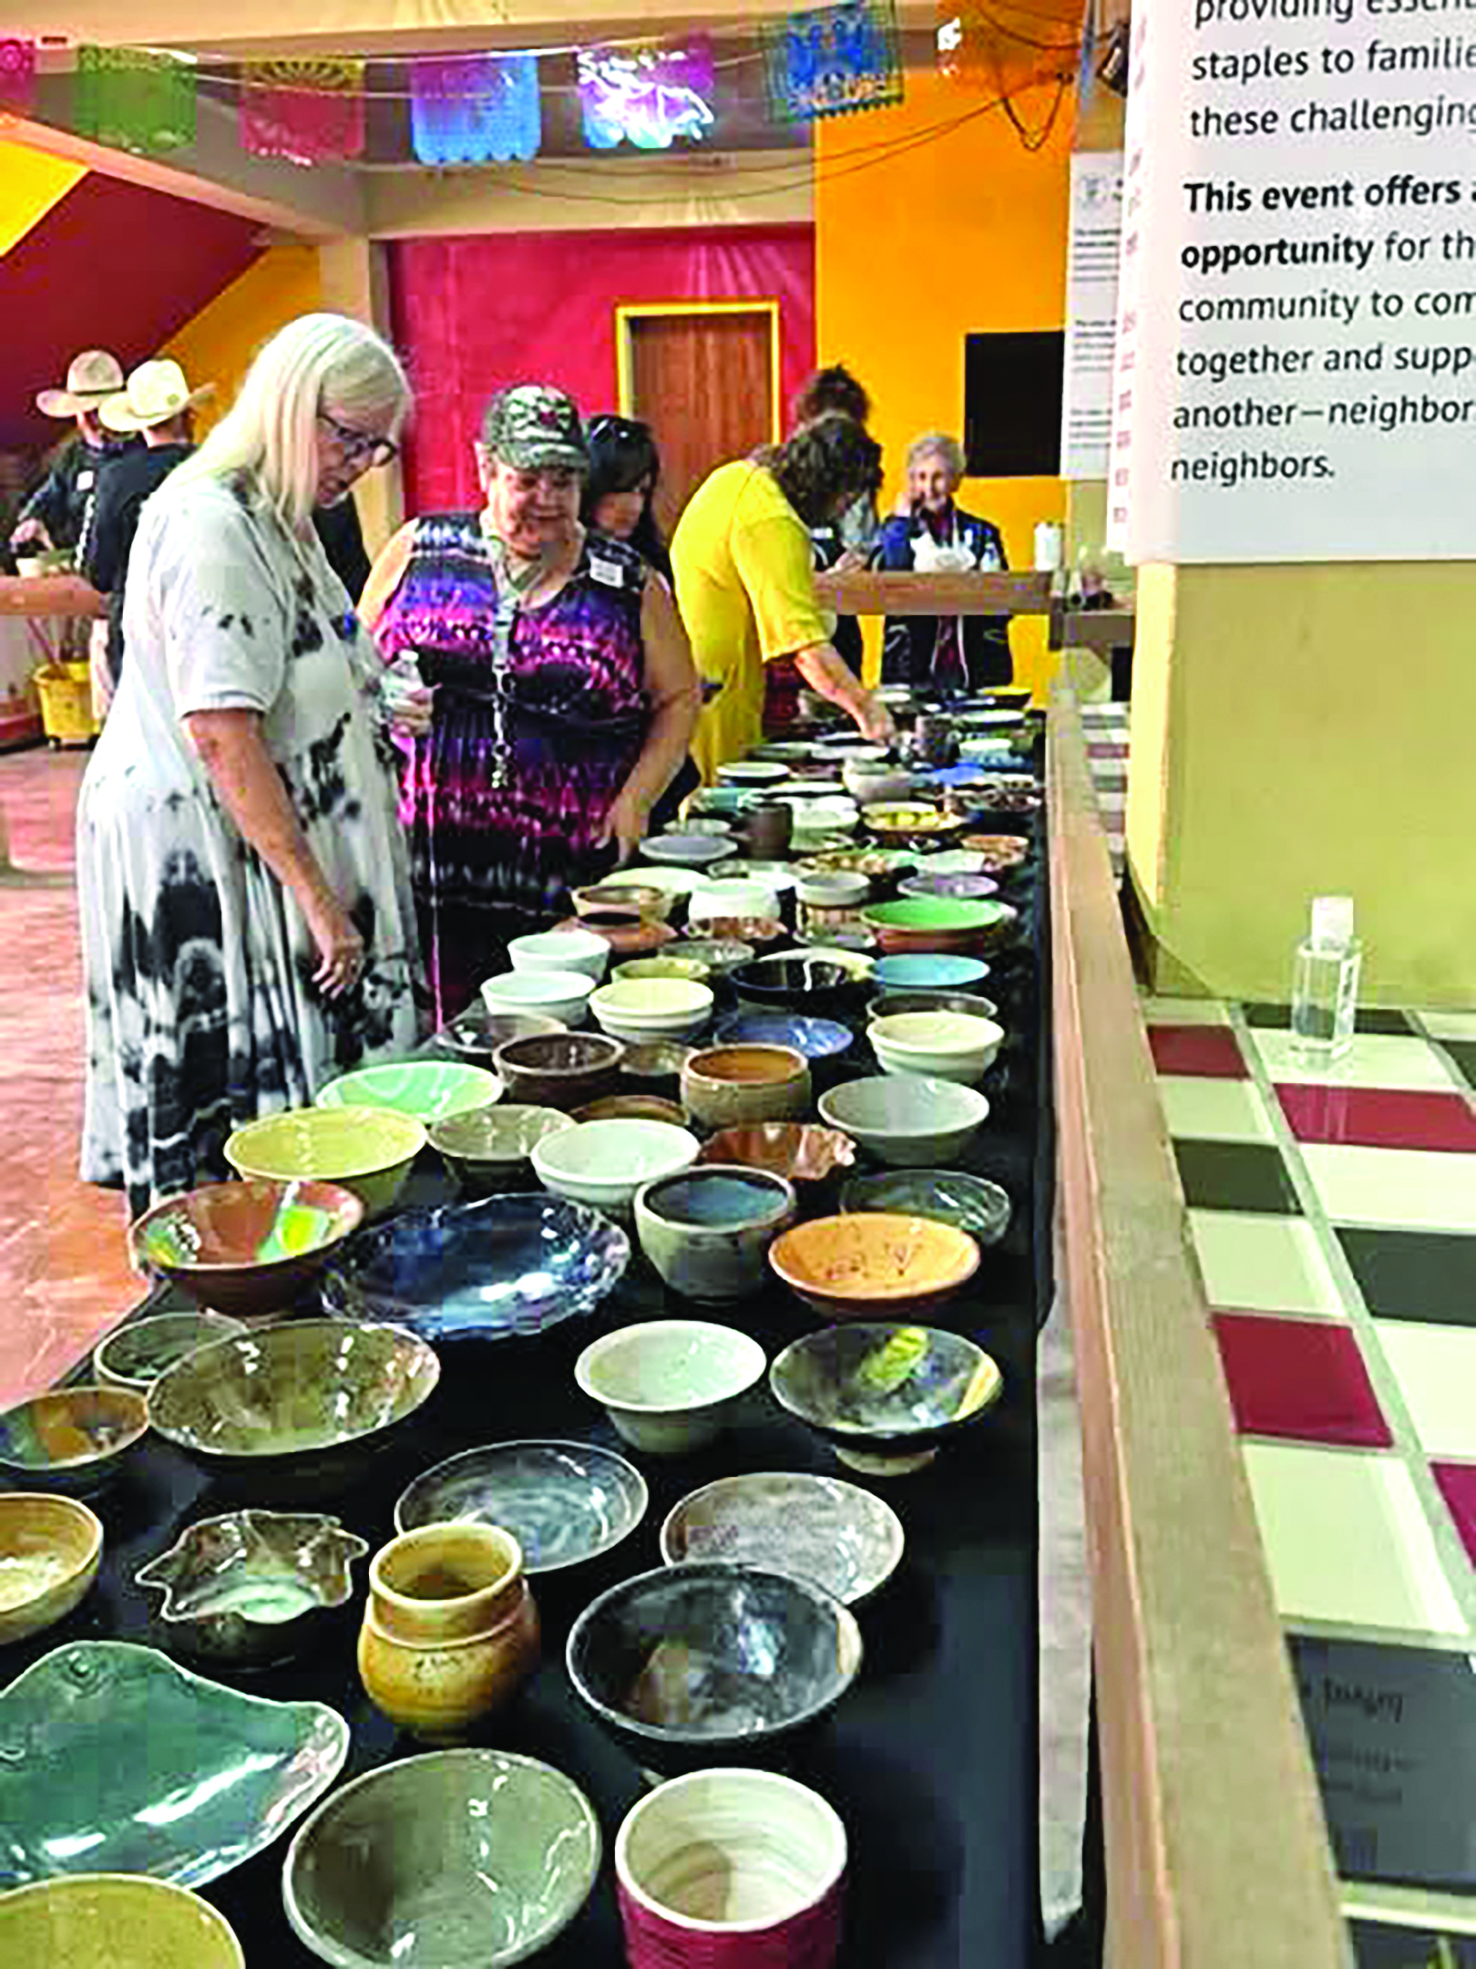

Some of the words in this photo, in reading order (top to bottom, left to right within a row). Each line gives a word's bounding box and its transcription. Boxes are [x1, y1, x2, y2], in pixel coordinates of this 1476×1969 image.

[1192, 46, 1309, 86] staples
[1321, 48, 1355, 74] to
[1190, 106, 1279, 137] these
[1182, 180, 1252, 213] This
[1261, 180, 1354, 211] event
[1364, 174, 1461, 207] offers
[1181, 233, 1375, 275] opportunity
[1385, 230, 1432, 262] for
[1442, 229, 1476, 260] th
[1179, 288, 1360, 325] community
[1371, 290, 1404, 317] to
[1176, 344, 1315, 384] together
[1323, 342, 1384, 372] and
[1394, 346, 1476, 376] supp
[1171, 450, 1336, 488] neighbors.
